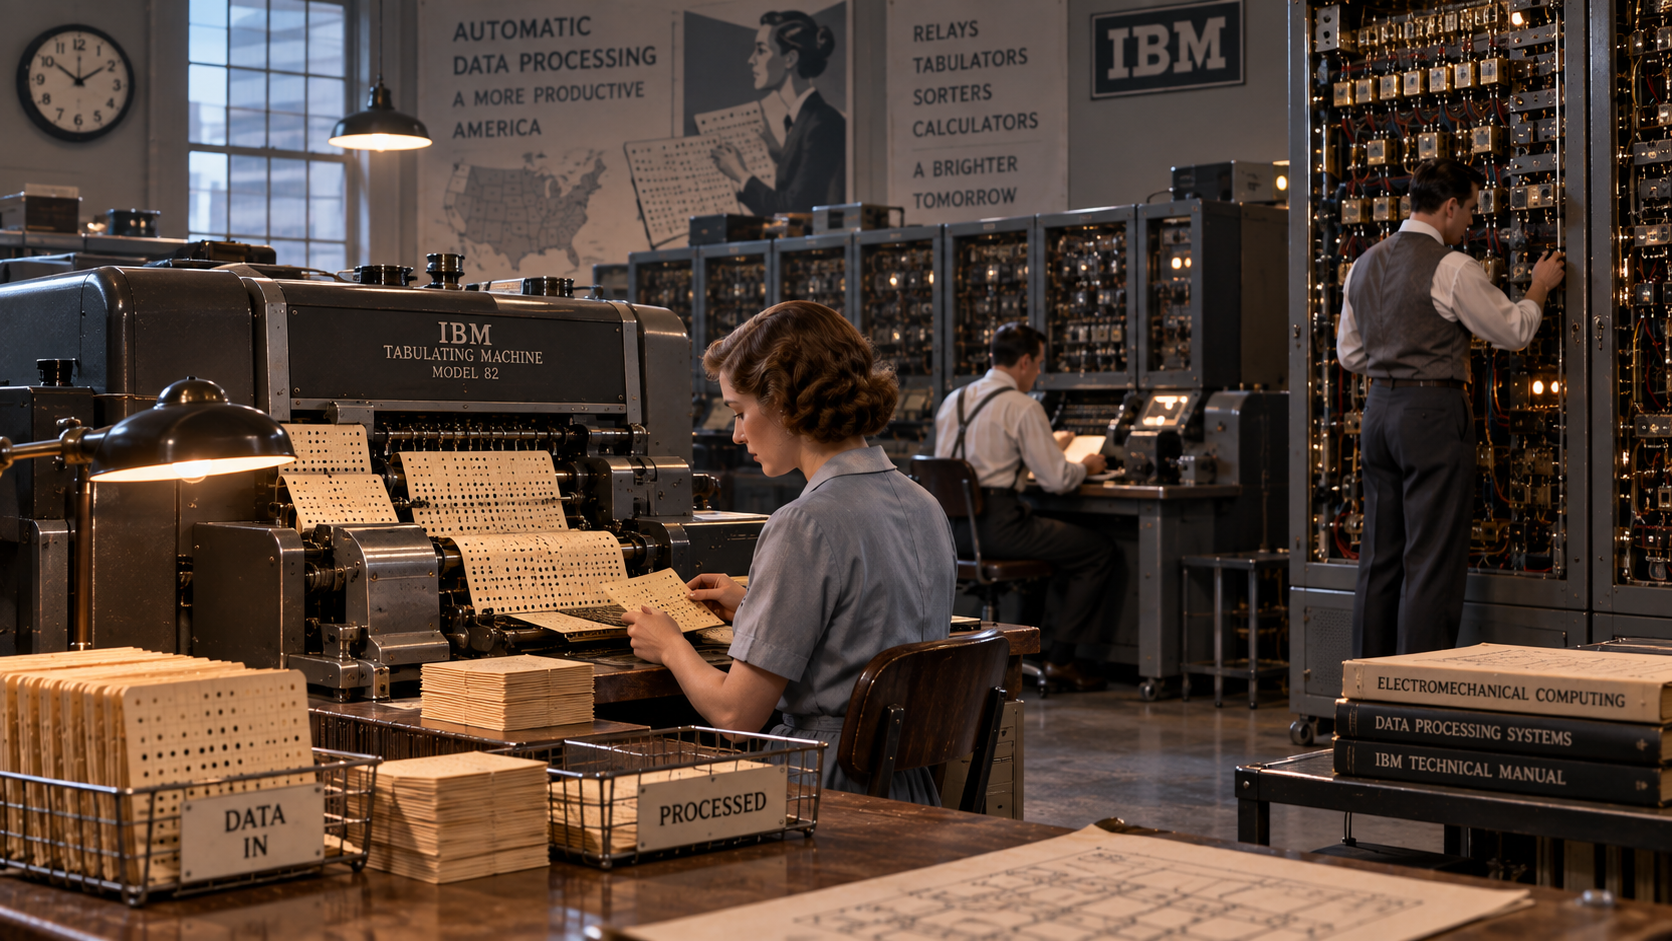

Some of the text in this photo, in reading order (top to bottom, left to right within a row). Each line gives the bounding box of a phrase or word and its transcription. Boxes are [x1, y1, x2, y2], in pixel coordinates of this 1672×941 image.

[453, 16, 590, 42] AUTOMATIC
[914, 20, 978, 42] RELAYS
[56, 42, 65, 54] 11
[72, 39, 86, 51] 12
[96, 45, 101, 57] 1
[1108, 17, 1225, 79] IBM
[41, 55, 54, 68] 10
[107, 60, 116, 72] 2
[454, 46, 656, 75] DATA PROCESSING
[913, 47, 1028, 73] TABULATORS
[36, 74, 45, 86] 9
[112, 79, 121, 91] 3
[42, 93, 51, 105] 8
[106, 98, 115, 109] 4
[453, 81, 644, 107] A MORE PRODUCTIVE
[914, 83, 992, 105] SORTERS
[56, 107, 64, 120] 7
[74, 114, 83, 126] 6
[94, 110, 102, 122] 5
[453, 119, 541, 138] AMERICA
[913, 112, 1038, 137] CALCULATORS
[913, 156, 1017, 178] A BRIGHTER
[914, 187, 1017, 208] TOMORROW
[438, 322, 492, 345] IBM
[384, 345, 542, 364] TABULATING MACHINE
[433, 366, 498, 379] MODEL 82
[1378, 677, 1625, 708] ELECTROMECHANICAL COMPUTING
[1376, 716, 1572, 746] DATA PROCESSING SYSTEMS
[1376, 753, 1566, 785] IBM TECHNICAL MANUAL
[225, 804, 286, 832] DATA
[660, 792, 766, 826] PROCESSED
[245, 835, 267, 858] IN
